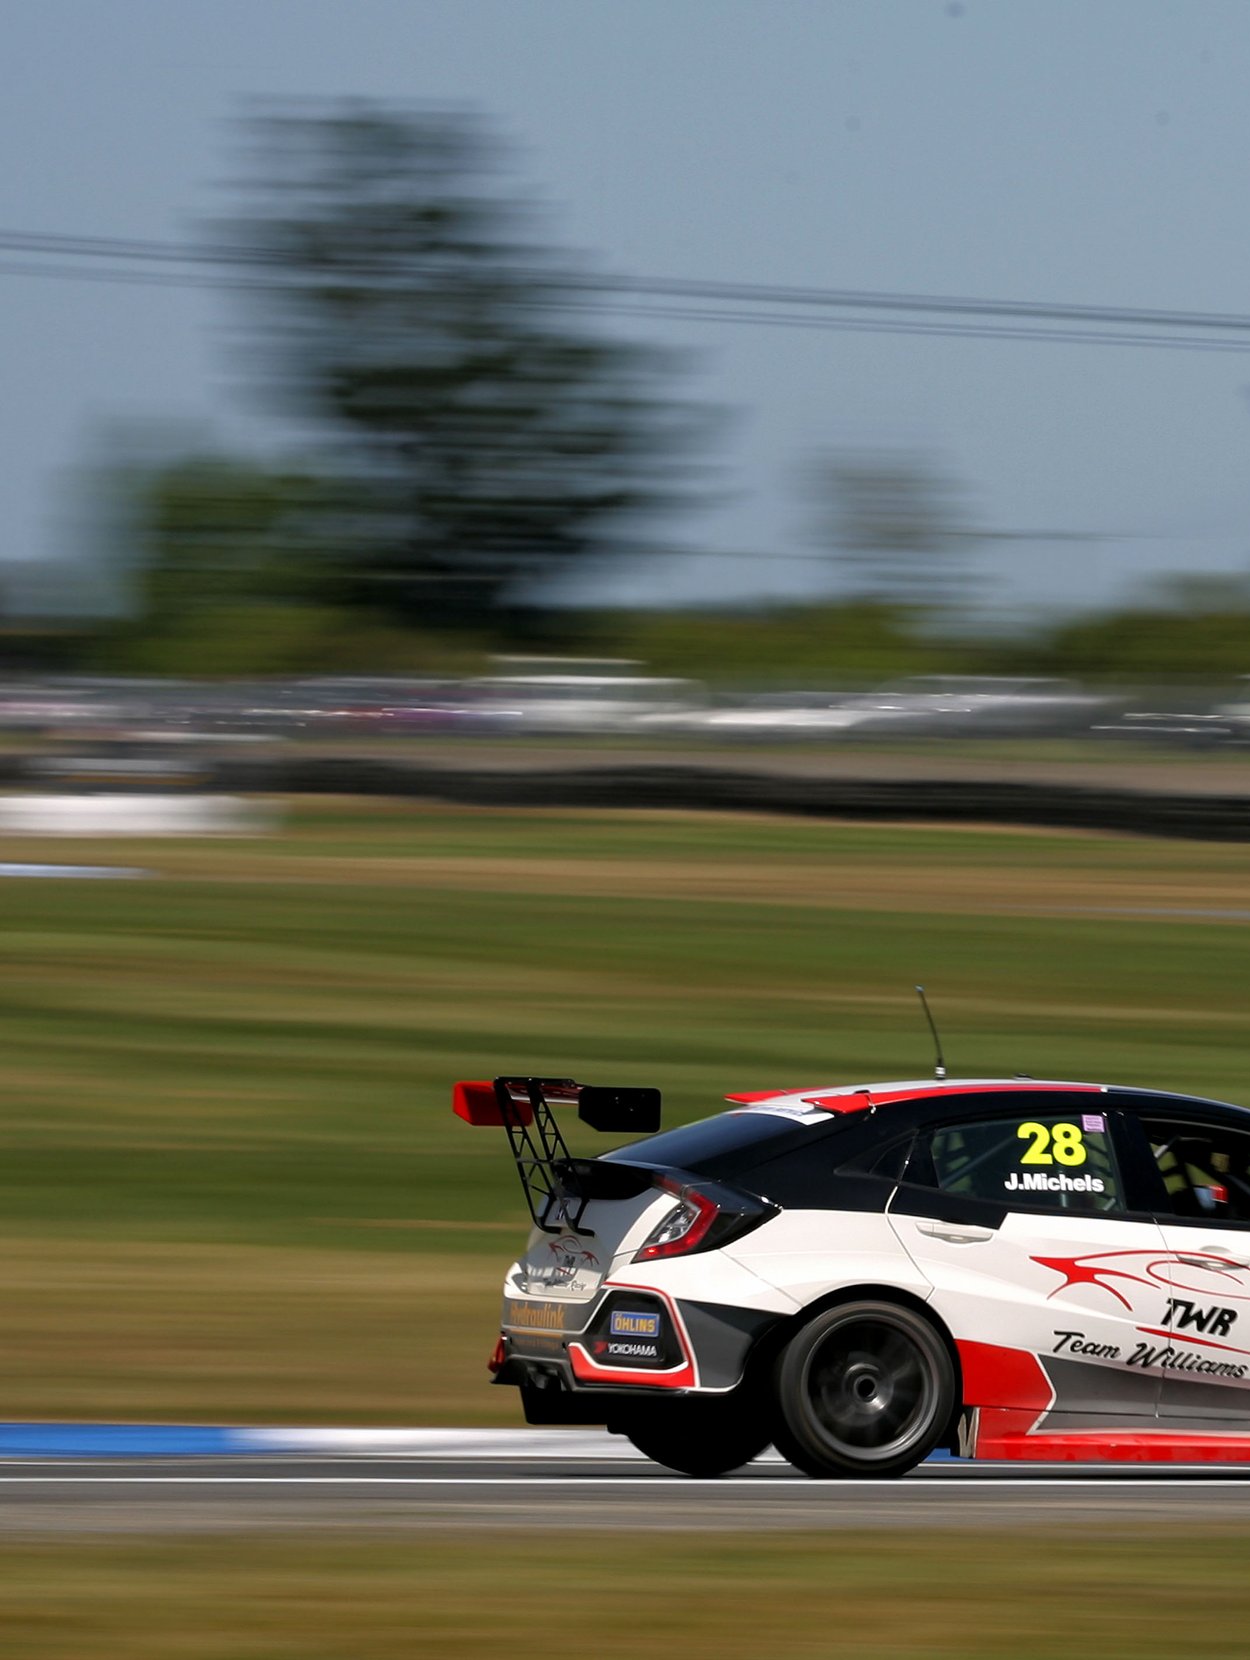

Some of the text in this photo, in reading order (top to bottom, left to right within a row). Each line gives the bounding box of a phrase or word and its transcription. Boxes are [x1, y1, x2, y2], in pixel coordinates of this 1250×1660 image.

[1017, 1122, 1087, 1167] 28
[1004, 1173, 1105, 1193] J.Michels
[614, 1313, 656, 1333] ÖHLINS
[1160, 1298, 1239, 1337] TWR
[608, 1343, 657, 1357] YOKOHAMA
[1052, 1330, 1121, 1359] Team
[1126, 1342, 1249, 1378] Williams
